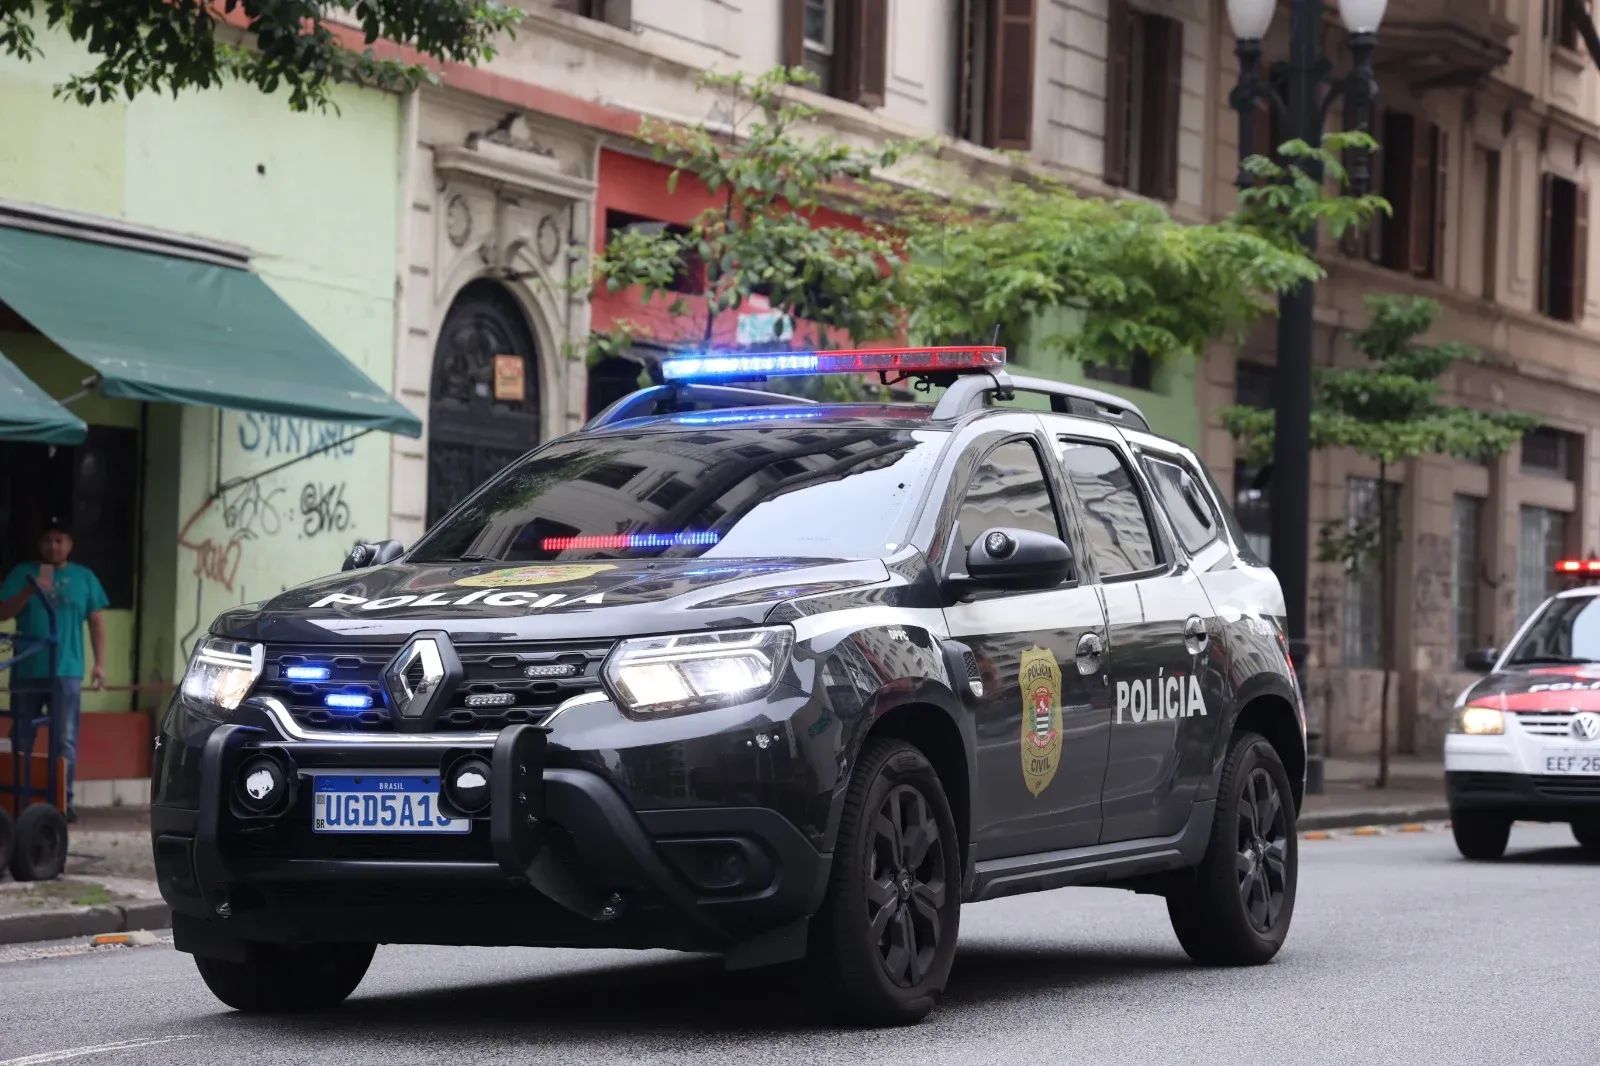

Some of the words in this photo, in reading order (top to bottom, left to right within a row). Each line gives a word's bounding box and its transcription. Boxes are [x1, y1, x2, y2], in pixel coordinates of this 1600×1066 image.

[308, 588, 605, 610] POLÍCIA
[1116, 666, 1208, 725] POLÍCIA
[1030, 757, 1051, 773] CIVIL
[379, 782, 404, 790] BRASIL
[325, 794, 452, 826] UGD5A1
[316, 819, 325, 829] BR
